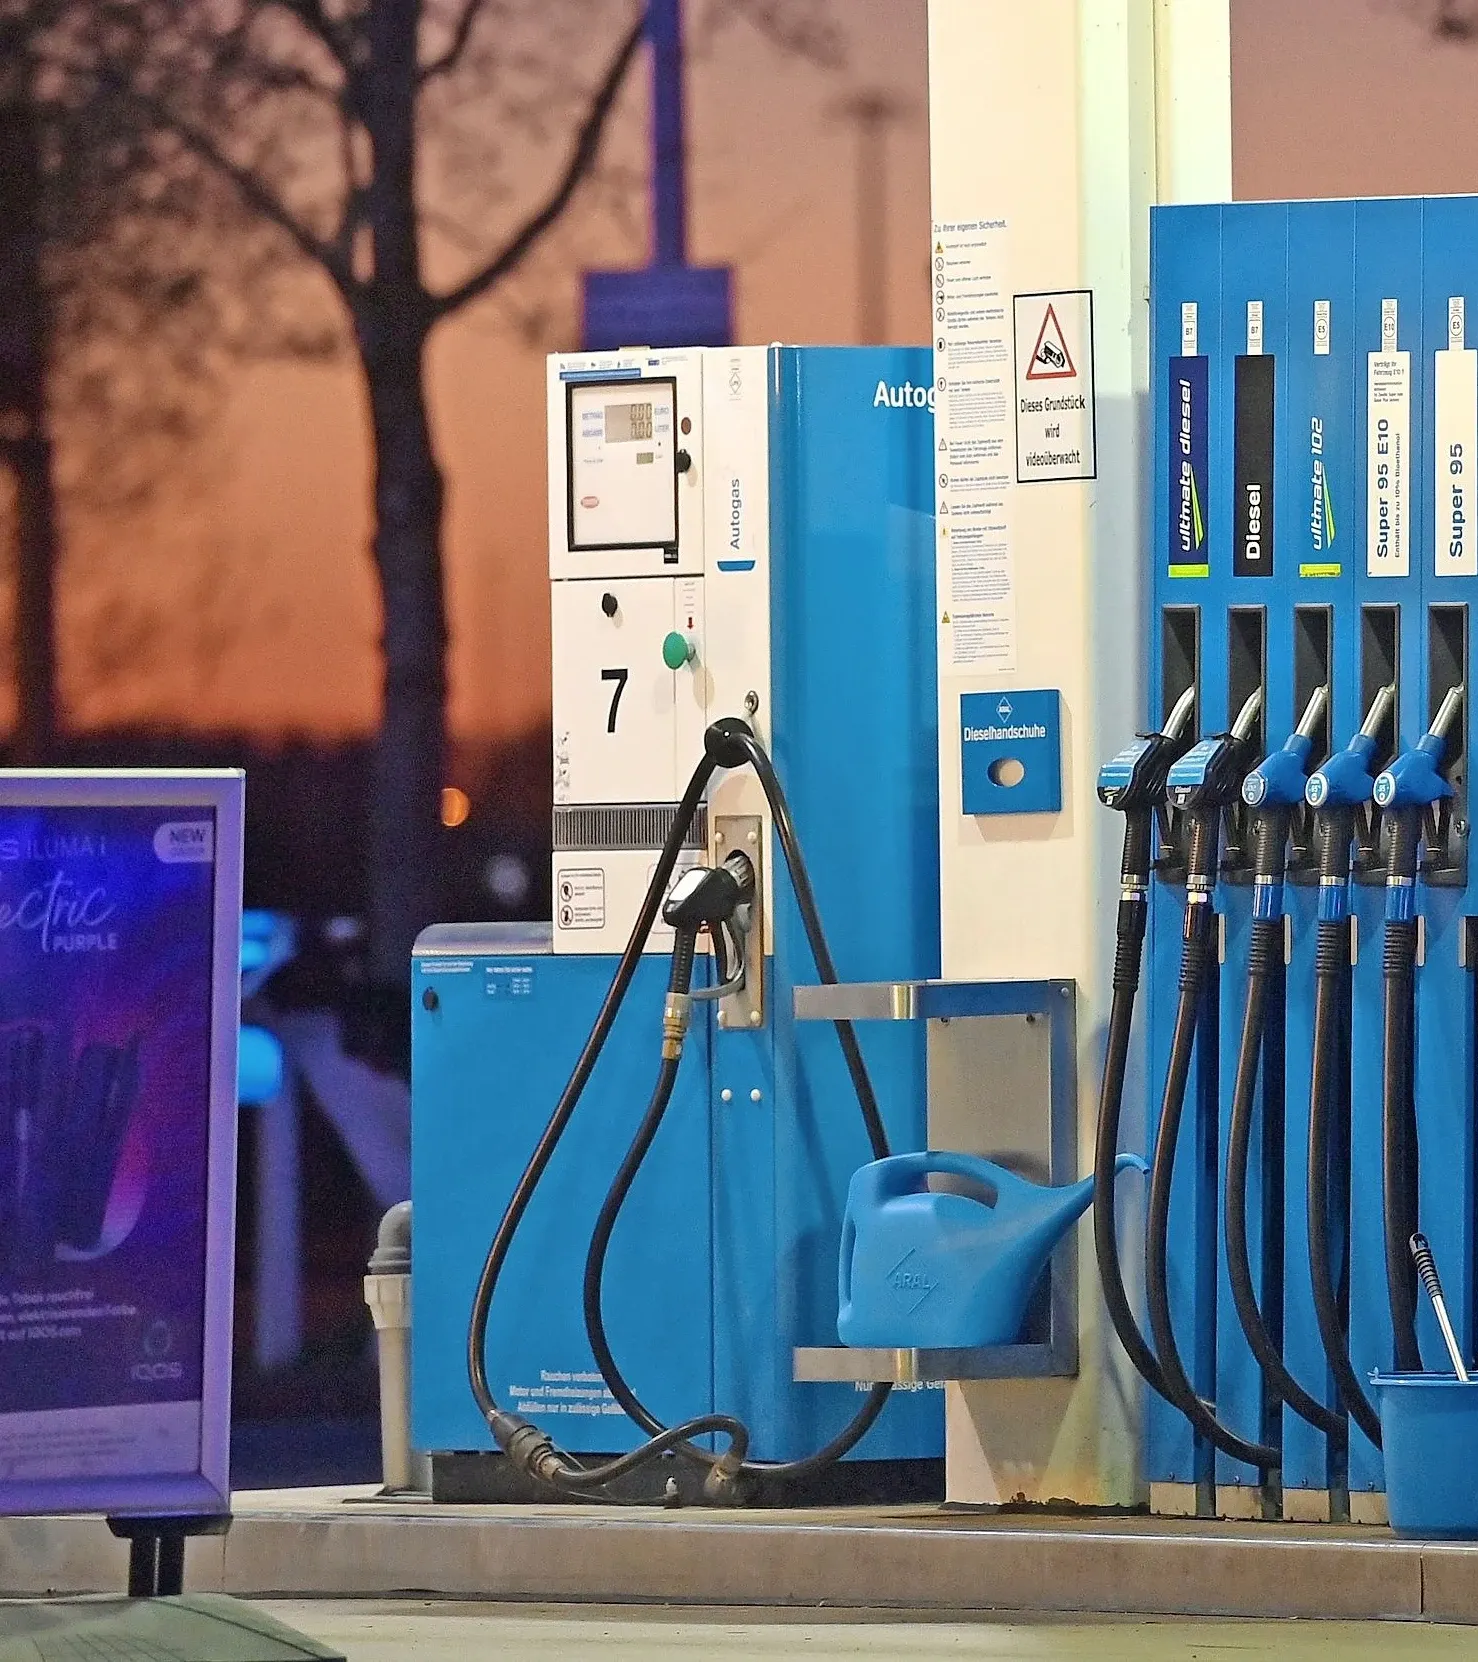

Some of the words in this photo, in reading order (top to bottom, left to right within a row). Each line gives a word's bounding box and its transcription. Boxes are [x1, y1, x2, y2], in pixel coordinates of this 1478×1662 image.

[1452, 321, 1460, 330] E5
[1020, 399, 1043, 413] Dieses
[1044, 394, 1086, 411] Grundstück
[1179, 379, 1191, 455] diesel
[1044, 423, 1060, 438] wird
[1311, 417, 1323, 455] 102
[1377, 419, 1389, 454] E10
[1025, 449, 1080, 467] videoüberwacht
[1449, 443, 1463, 474] 95
[1377, 463, 1389, 489] 95
[730, 478, 742, 550] Autogas
[1179, 460, 1191, 552] ultimate
[1246, 484, 1261, 560] Diesel
[1311, 460, 1323, 550] ultimate
[1449, 485, 1465, 557] Super
[1377, 498, 1390, 558] Super
[601, 668, 628, 733] 7
[964, 724, 1046, 742] Dieselhandschuhe
[53, 933, 118, 951] PURPLE
[892, 1271, 931, 1290] ARAL
